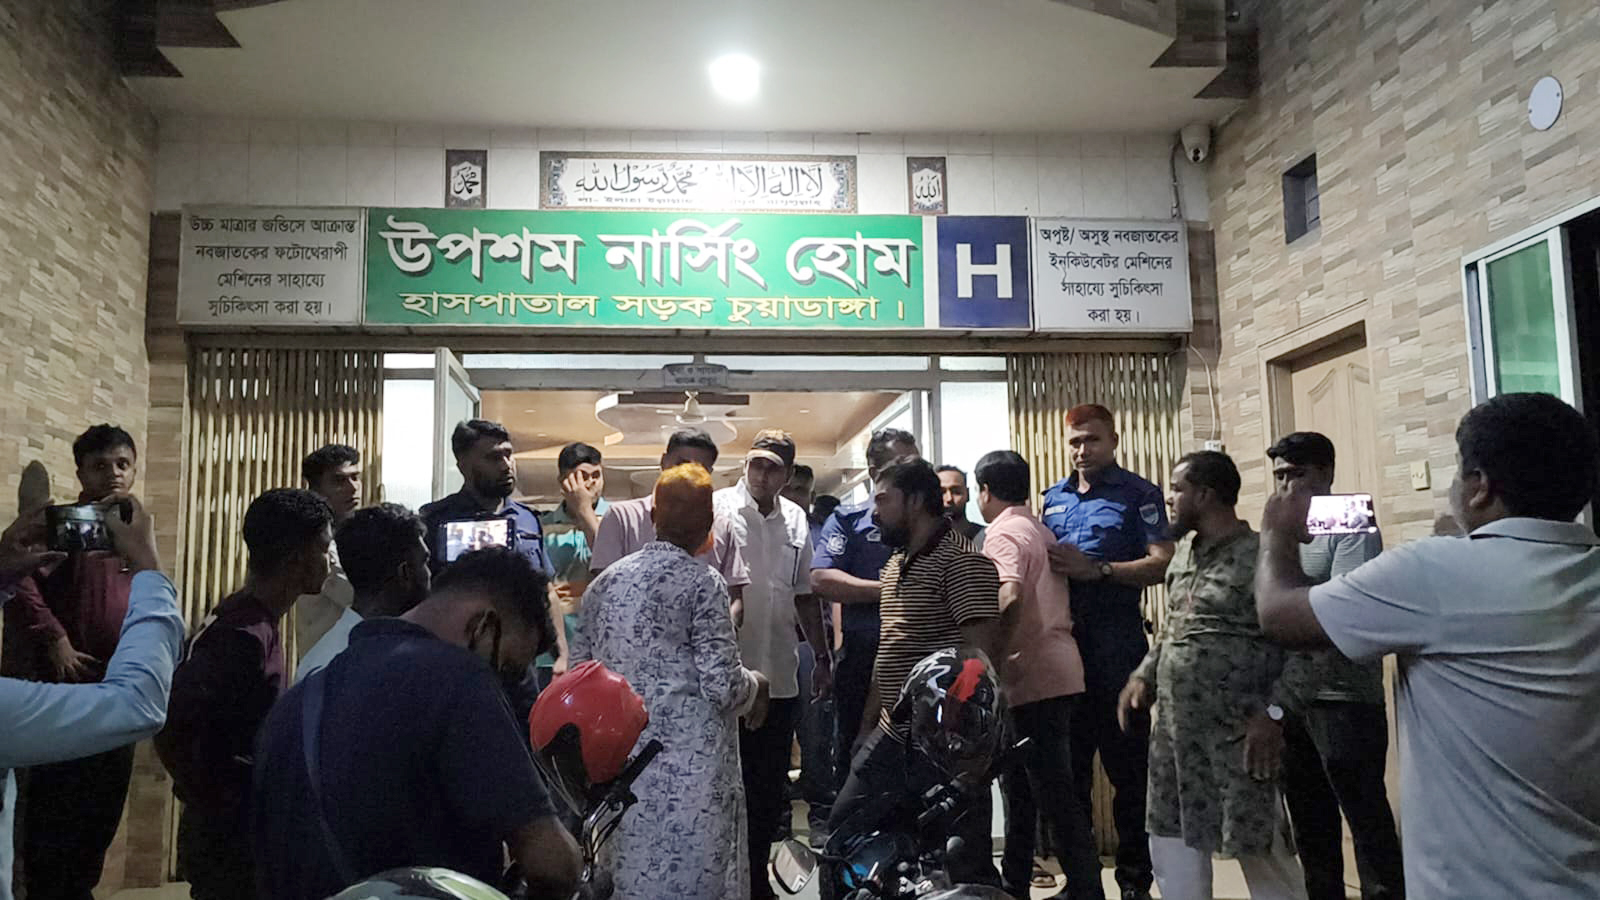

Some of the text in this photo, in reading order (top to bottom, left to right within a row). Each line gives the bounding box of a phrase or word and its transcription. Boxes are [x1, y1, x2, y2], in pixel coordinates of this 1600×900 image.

[191, 215, 357, 233] উচ্চ মাত্রার জন্ডিসে আক্রান্ত
[1079, 229, 1110, 246] অসুস্থ
[1114, 229, 1179, 244] নবজাতকের
[195, 241, 348, 260] নবজাতকের ফটোথেরাপী
[378, 215, 919, 295] উপশম নার্সিং হোম
[956, 243, 1012, 298] H
[1049, 252, 1173, 270] ইনকিউবেটর মেশিনের
[217, 268, 326, 288] মেশিনের সাহায্যে
[1062, 278, 1163, 298] সাহায্যে সুচিকিৎসা
[208, 296, 269, 317] সুচিকিৎসা
[274, 300, 298, 314] করা
[304, 300, 322, 315] হয়
[399, 291, 600, 317] হাসপাতাল
[611, 296, 716, 321] সড়ক
[726, 295, 880, 325] চুয়াডাঙ্গা
[1087, 308, 1110, 323] করা
[1114, 309, 1132, 323] হয়
